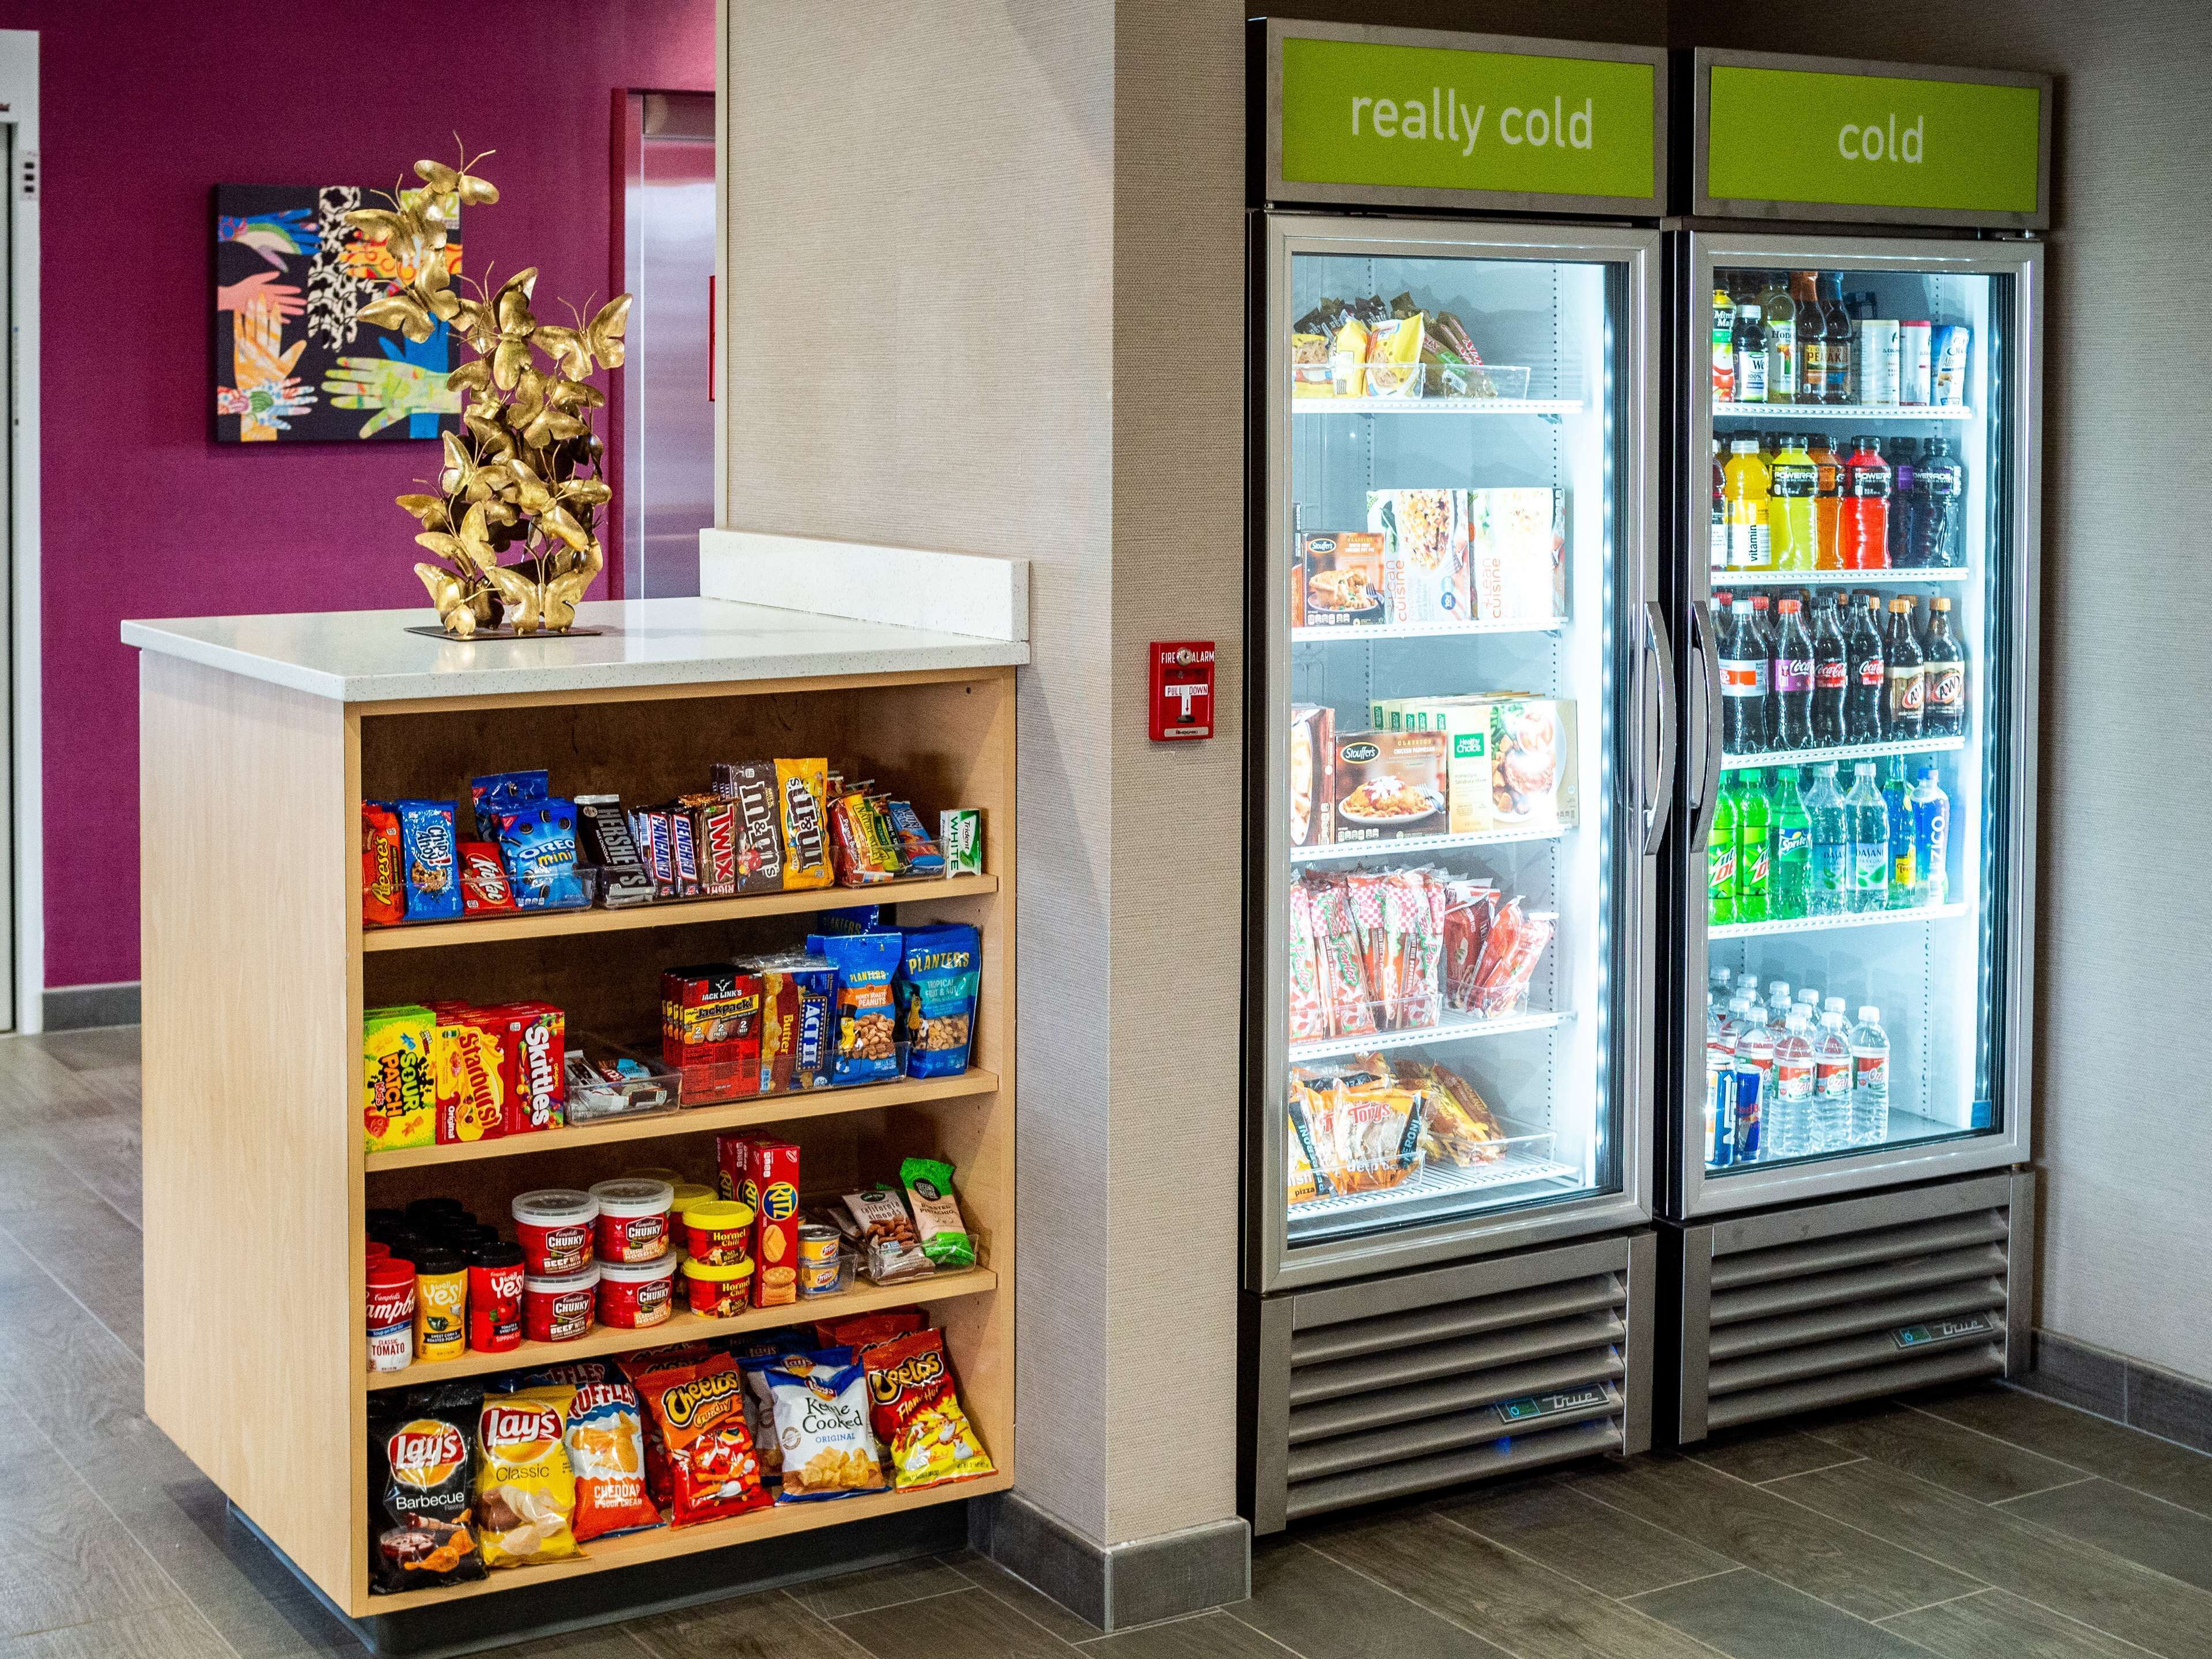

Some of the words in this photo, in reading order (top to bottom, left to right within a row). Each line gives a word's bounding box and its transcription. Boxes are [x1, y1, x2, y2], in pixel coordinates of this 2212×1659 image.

[1351, 87, 1485, 156] really
[1499, 96, 1593, 149] cold
[1838, 116, 1924, 164] cold
[1312, 542, 1333, 551] Stouffer's
[1483, 558, 1492, 596] Lean
[1492, 558, 1501, 618] cuisine
[1397, 560, 1406, 622] cuisine
[1162, 652, 1175, 664] FIRE
[1192, 651, 1215, 662] ALARM
[1167, 687, 1181, 695] PULL
[1189, 686, 1208, 695] DOWN
[1345, 746, 1376, 759] Stouffer's
[1457, 744, 1481, 753] Choice
[1459, 738, 1480, 746] Healthy
[842, 818, 853, 841] Peanut
[1930, 815, 1946, 864] ZICO
[426, 826, 448, 858] Chips
[519, 839, 575, 860] OREO
[597, 808, 648, 887] HERSHEY'S
[675, 818, 696, 876] BENCHED
[708, 803, 735, 882] TWIX
[951, 815, 959, 871] WHITE
[1782, 836, 1807, 852] Sprite
[537, 849, 573, 866] mini
[909, 951, 970, 975] PLANTERS
[1335, 939, 1359, 986] Parlor
[849, 970, 886, 983] PLANTERS
[702, 993, 719, 1001] JACK
[720, 989, 742, 999] LINK'S
[855, 993, 869, 1001] HONEY
[857, 997, 887, 1007] PEANUTS
[695, 996, 754, 1019] Jackpack!
[804, 1004, 820, 1040] ACT
[782, 1014, 794, 1054] Butter
[801, 1042, 818, 1064] II
[381, 1052, 404, 1117] PATCH
[399, 1051, 421, 1110] SOUR
[460, 1032, 500, 1127] Starburst
[525, 1025, 554, 1127] Skittles
[447, 1105, 455, 1139] Original
[1347, 1102, 1392, 1124] Tony's
[767, 1182, 793, 1219] RITZ
[1295, 1186, 1315, 1197] pizza
[548, 1234, 584, 1248] CHUNKY
[627, 1225, 663, 1239] CHUNKY
[713, 1229, 747, 1241] Hormel
[721, 1237, 740, 1246] Chili
[543, 1257, 569, 1268] BEEF
[423, 1280, 462, 1306] Yes!
[491, 1270, 524, 1299] Yes!
[639, 1287, 671, 1303] CHUNKY
[729, 1288, 746, 1297] Chili
[366, 1286, 415, 1324] ampb
[375, 1291, 401, 1302] Campbell's
[555, 1299, 590, 1314] CHUNKY
[550, 1323, 574, 1335] BEEF
[371, 1342, 405, 1356] TOMATO
[664, 1371, 739, 1426] Cheetos
[1542, 1392, 1599, 1409] True
[693, 1398, 731, 1428] Crunchy
[802, 1410, 863, 1434] Cooked
[488, 1408, 556, 1448] Lay's
[815, 1433, 856, 1444] ORIGINAL
[396, 1433, 458, 1470] Lay's
[496, 1464, 550, 1482] Classic
[396, 1491, 464, 1510] Barbecue
[594, 1484, 640, 1499] CHEDDAR
[620, 1498, 642, 1507] CREAM
